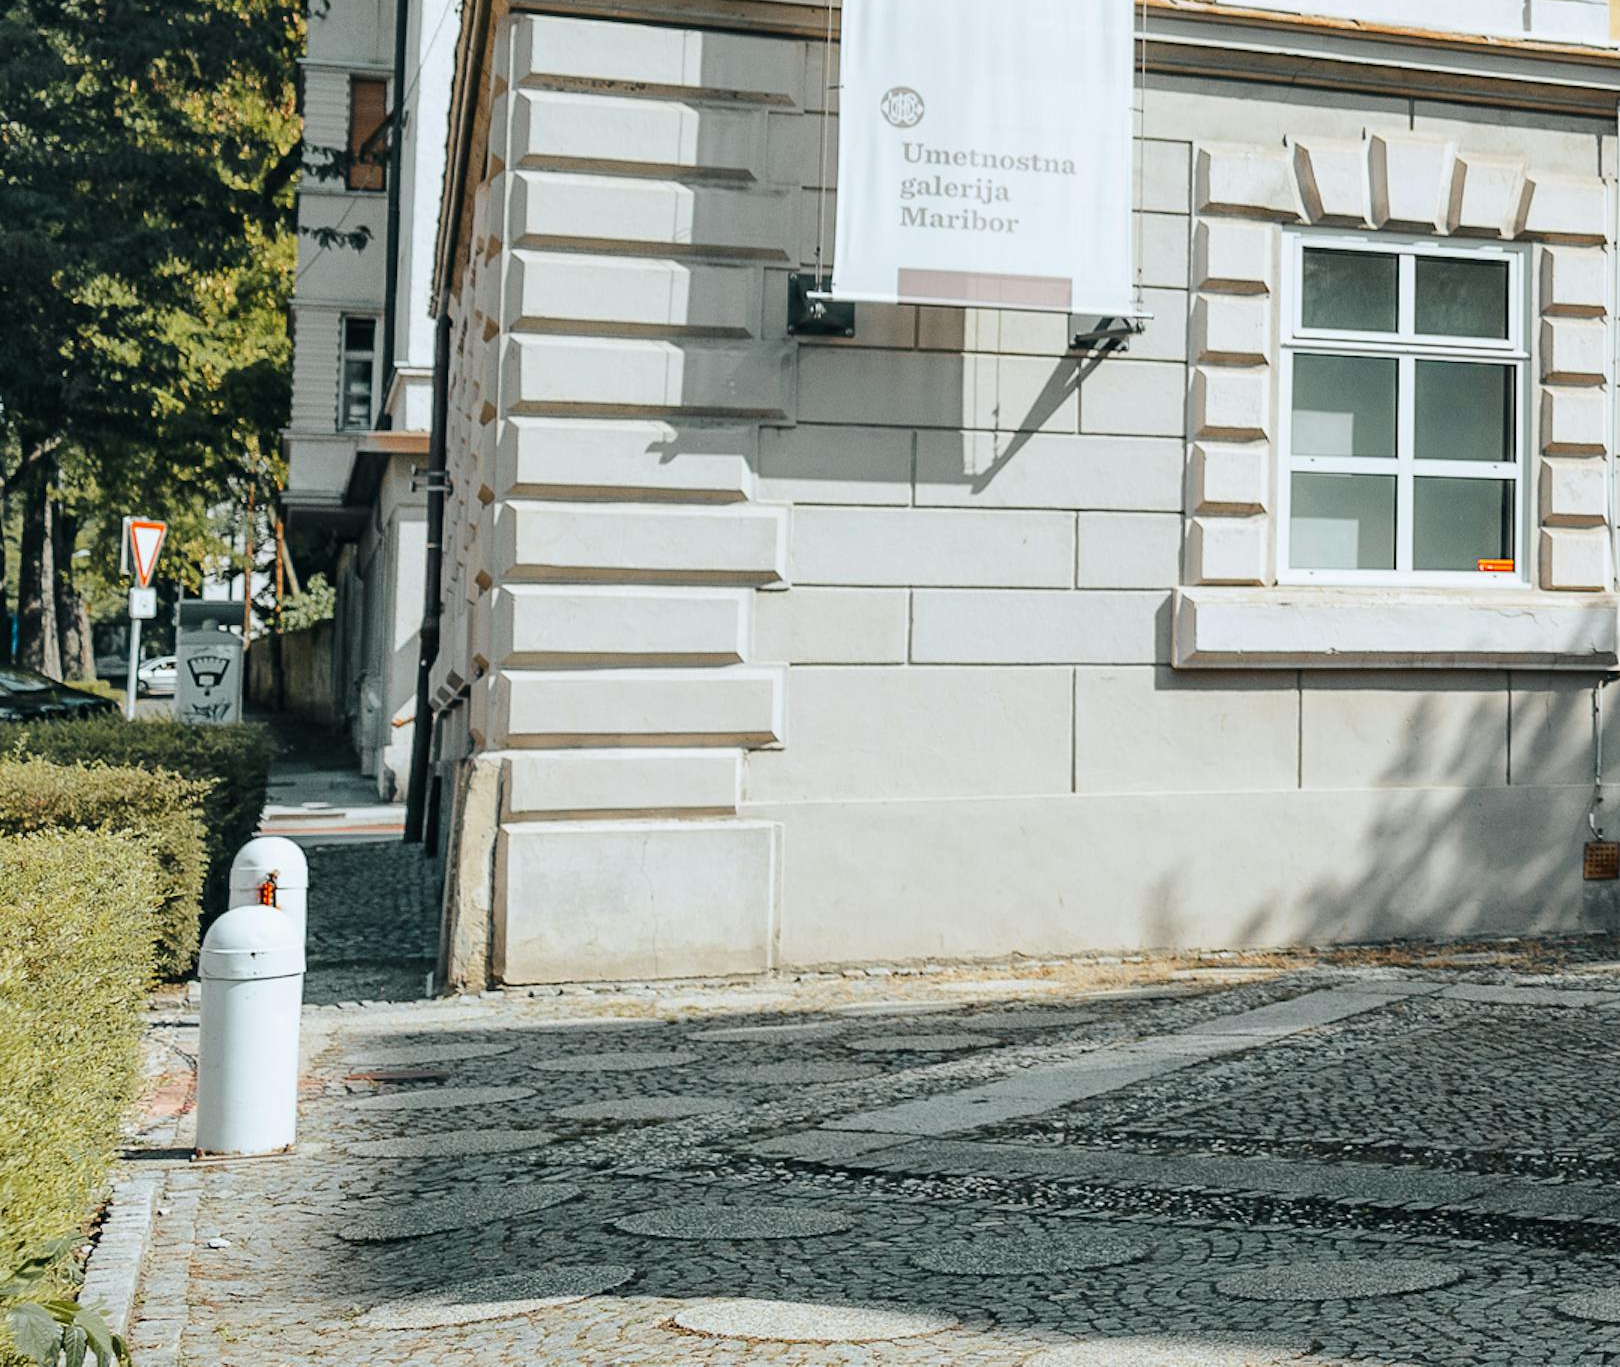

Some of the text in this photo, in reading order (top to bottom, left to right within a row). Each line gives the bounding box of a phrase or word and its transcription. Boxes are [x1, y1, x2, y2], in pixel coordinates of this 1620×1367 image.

[902, 141, 1077, 175] Umetnostna
[899, 175, 1010, 205] galerija
[899, 206, 1020, 234] Maribor
